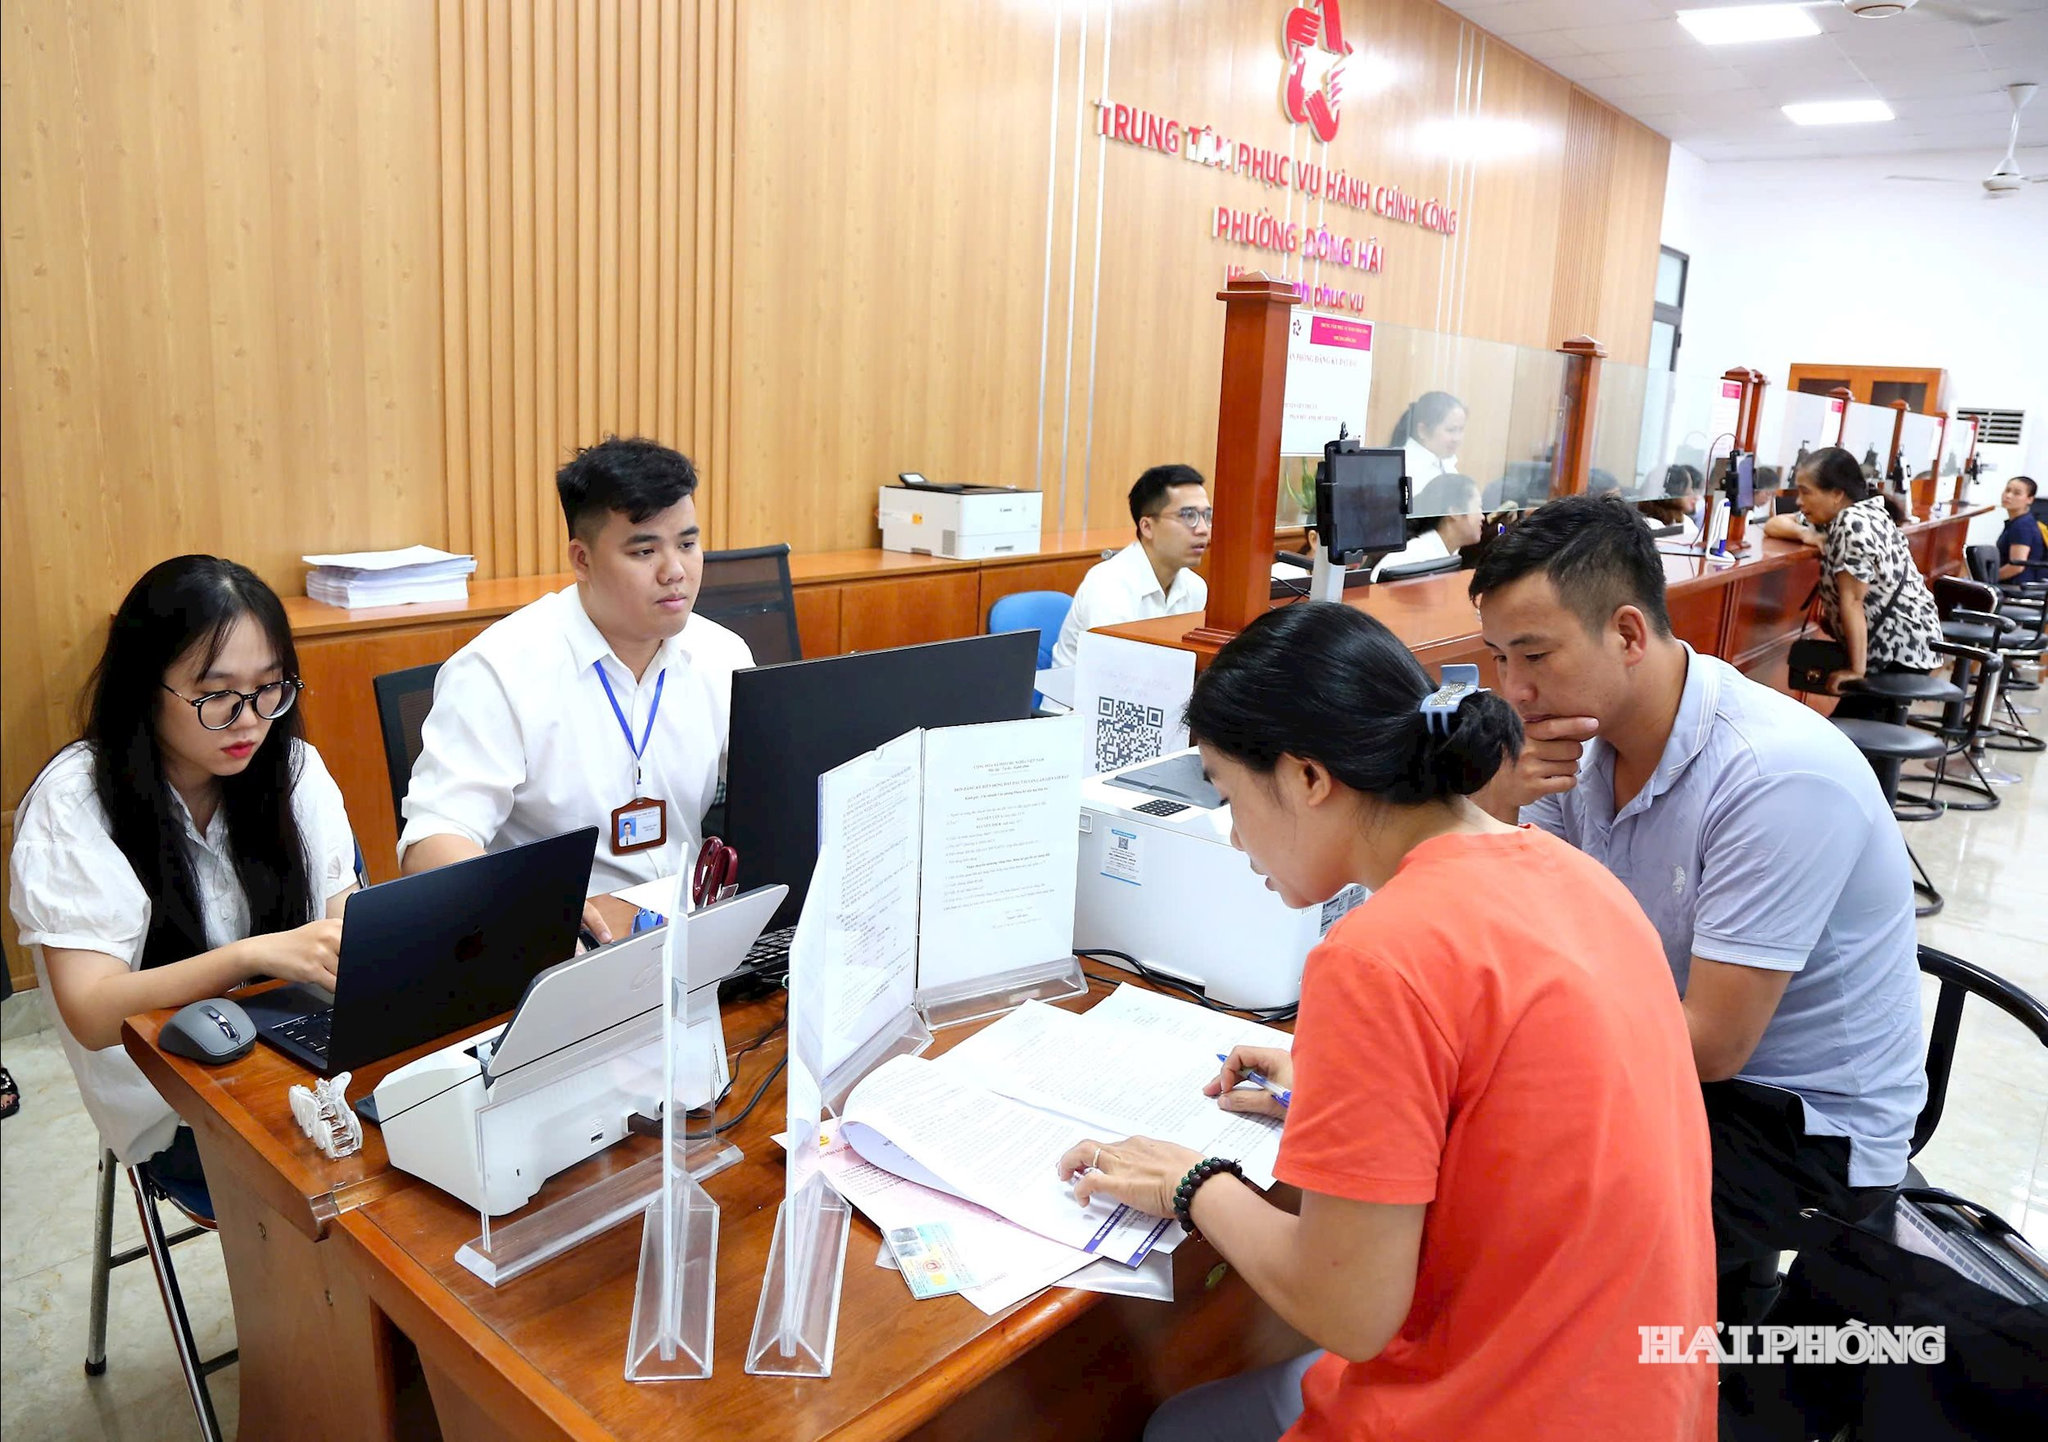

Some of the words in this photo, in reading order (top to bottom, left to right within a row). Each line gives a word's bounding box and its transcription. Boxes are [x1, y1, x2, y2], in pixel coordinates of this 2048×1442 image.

[1097, 98, 1180, 155] TRUNG
[1237, 142, 1291, 190] PHỤC
[1297, 160, 1321, 200] VỤ
[1326, 168, 1371, 211] HÀNH
[1421, 198, 1457, 236] CÔNG
[1216, 206, 1297, 254] PHƯỜNG
[1314, 282, 1346, 313] phục
[1349, 291, 1365, 316] vụ
